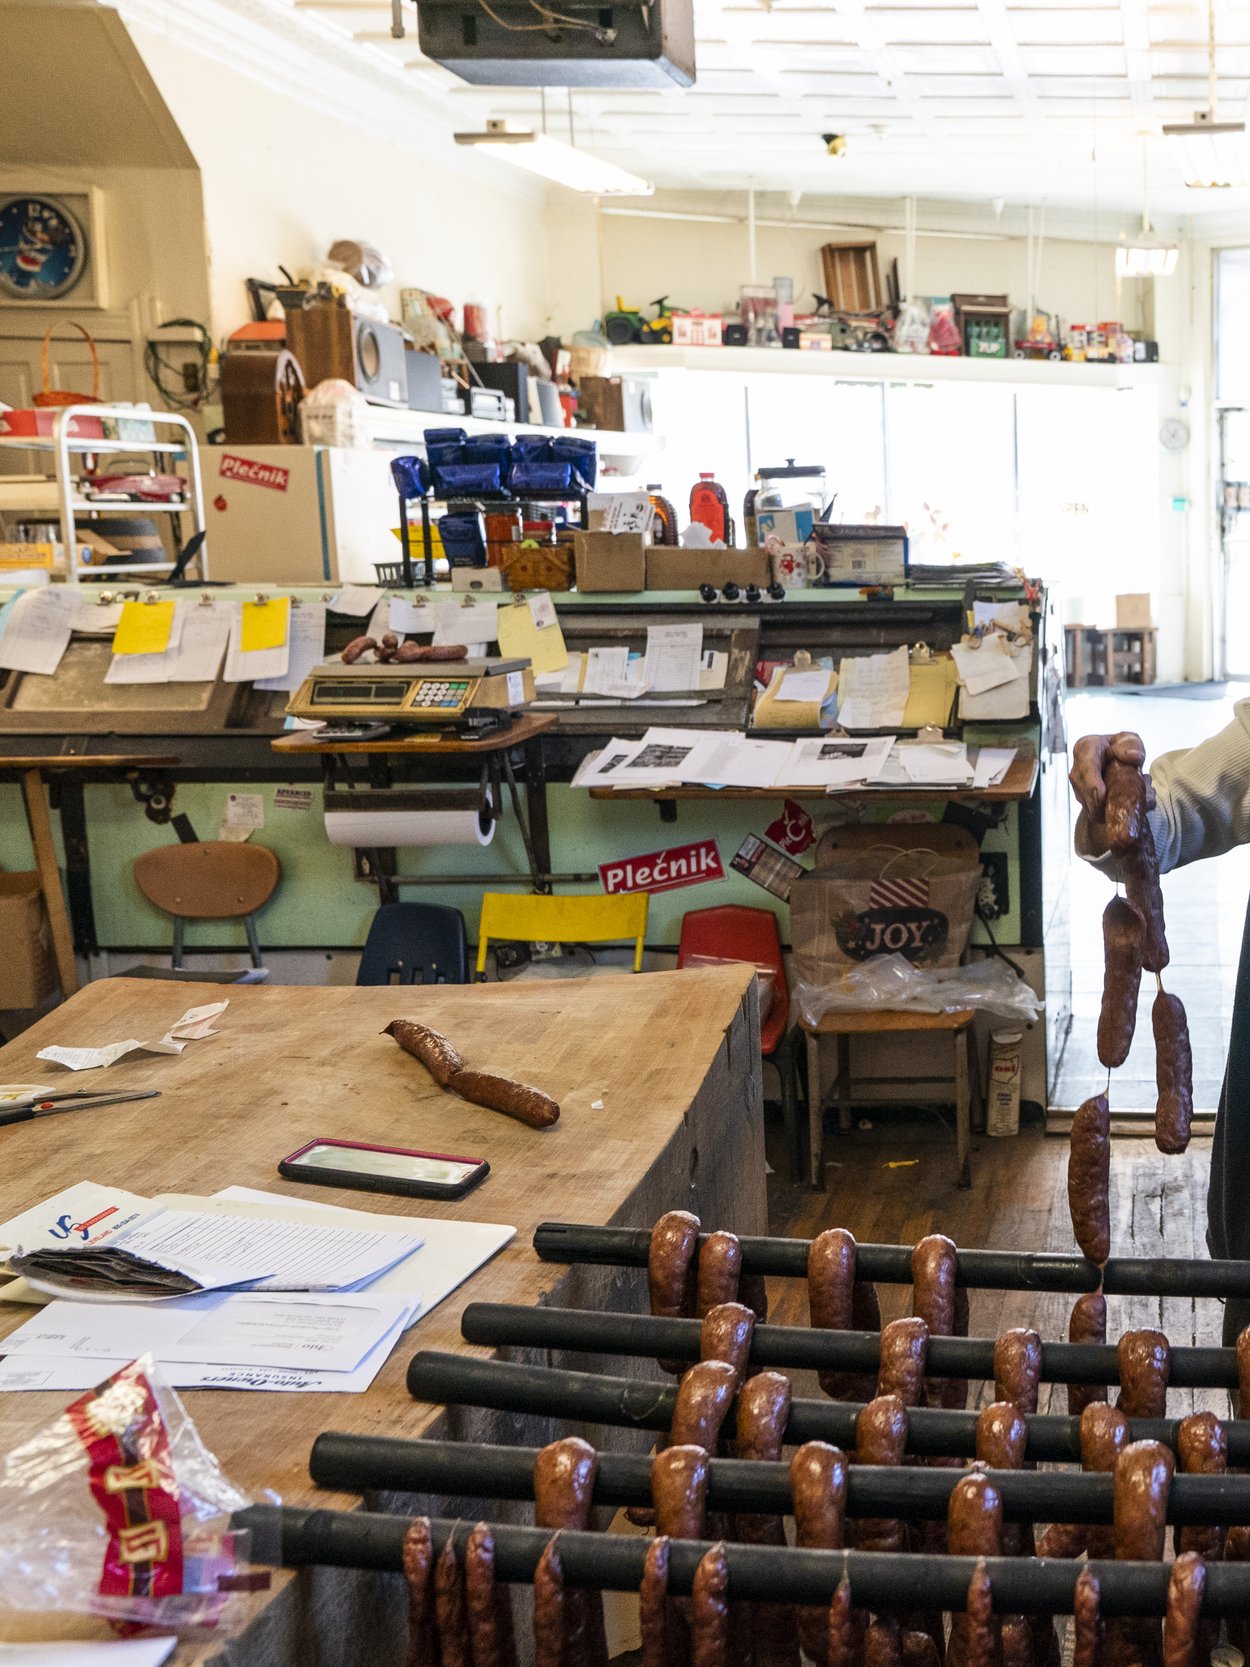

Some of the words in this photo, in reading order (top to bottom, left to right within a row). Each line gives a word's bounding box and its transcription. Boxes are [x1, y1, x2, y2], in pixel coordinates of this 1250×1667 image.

[607, 847, 718, 891] Plečnik
[865, 921, 930, 950] JOY
[199, 1375, 323, 1390] Auto-Owners
[229, 1371, 303, 1381] INSURANCE
